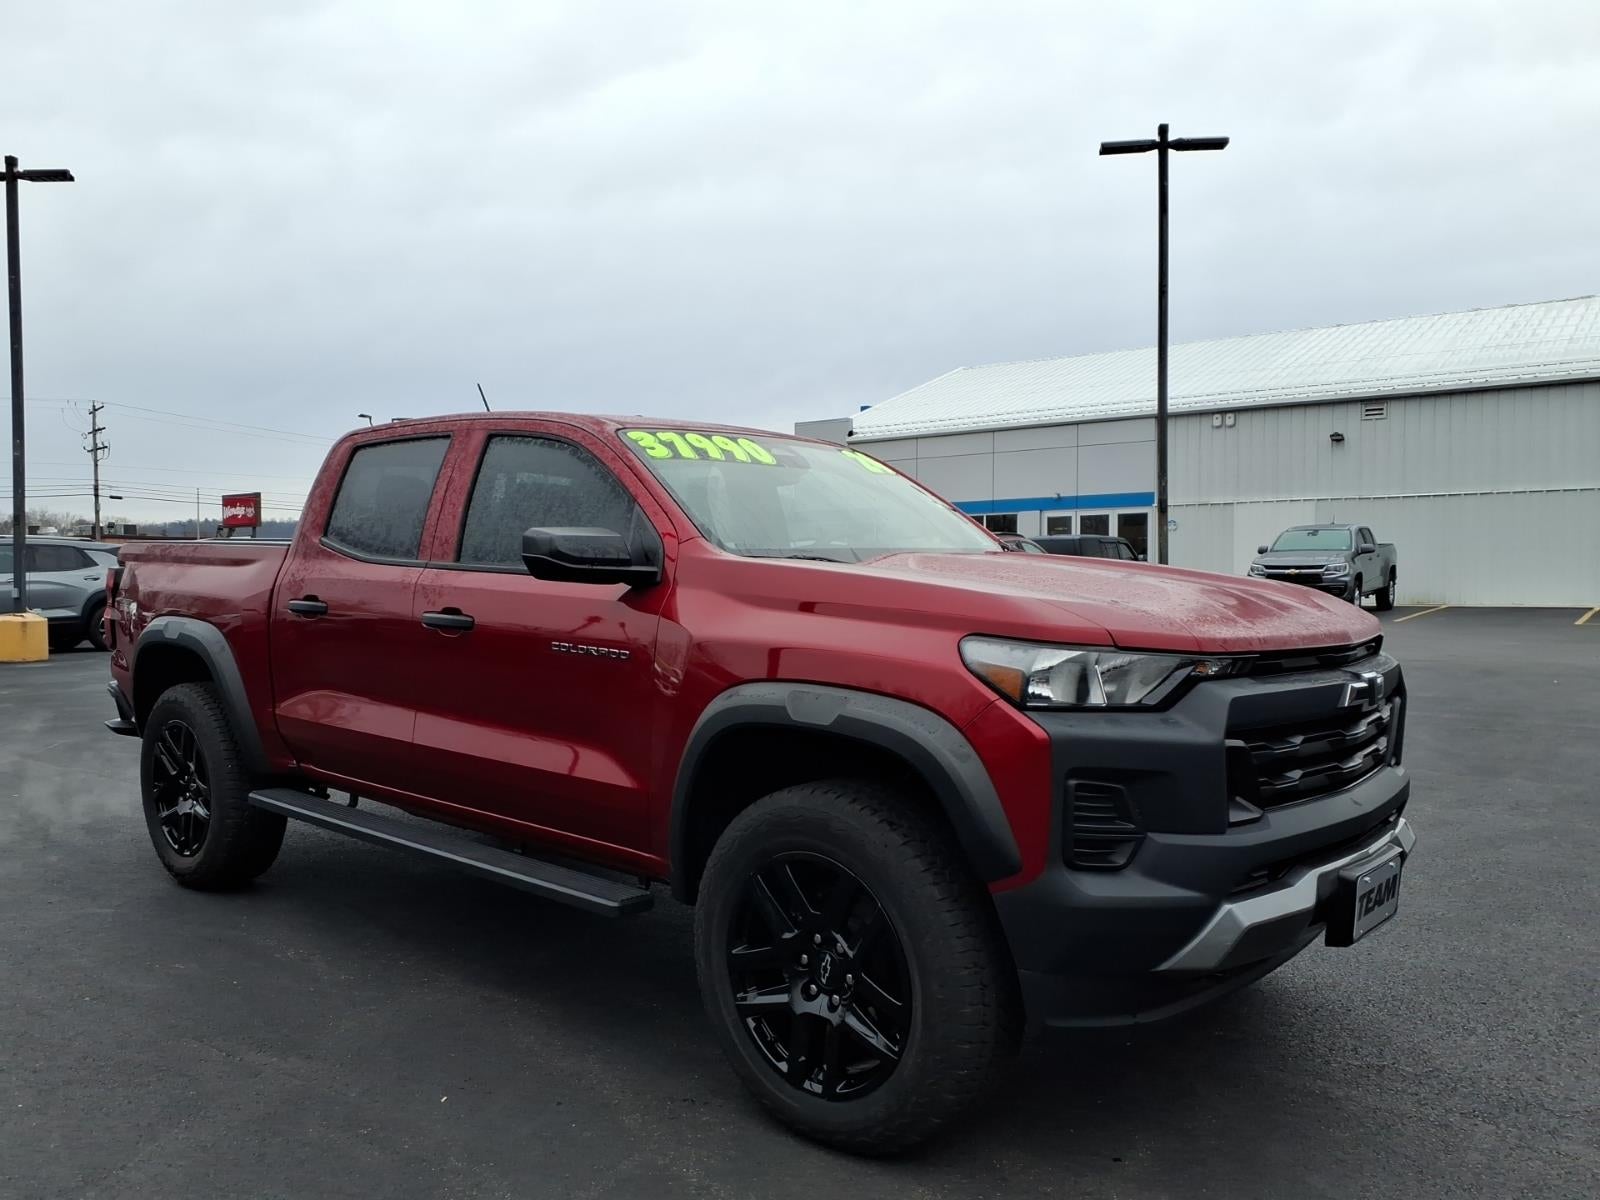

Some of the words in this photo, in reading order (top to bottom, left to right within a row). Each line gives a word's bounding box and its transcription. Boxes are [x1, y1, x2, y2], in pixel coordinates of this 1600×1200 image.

[626, 431, 777, 465] 37990
[551, 641, 630, 659] COLORADO
[1358, 873, 1398, 921] TEAM
